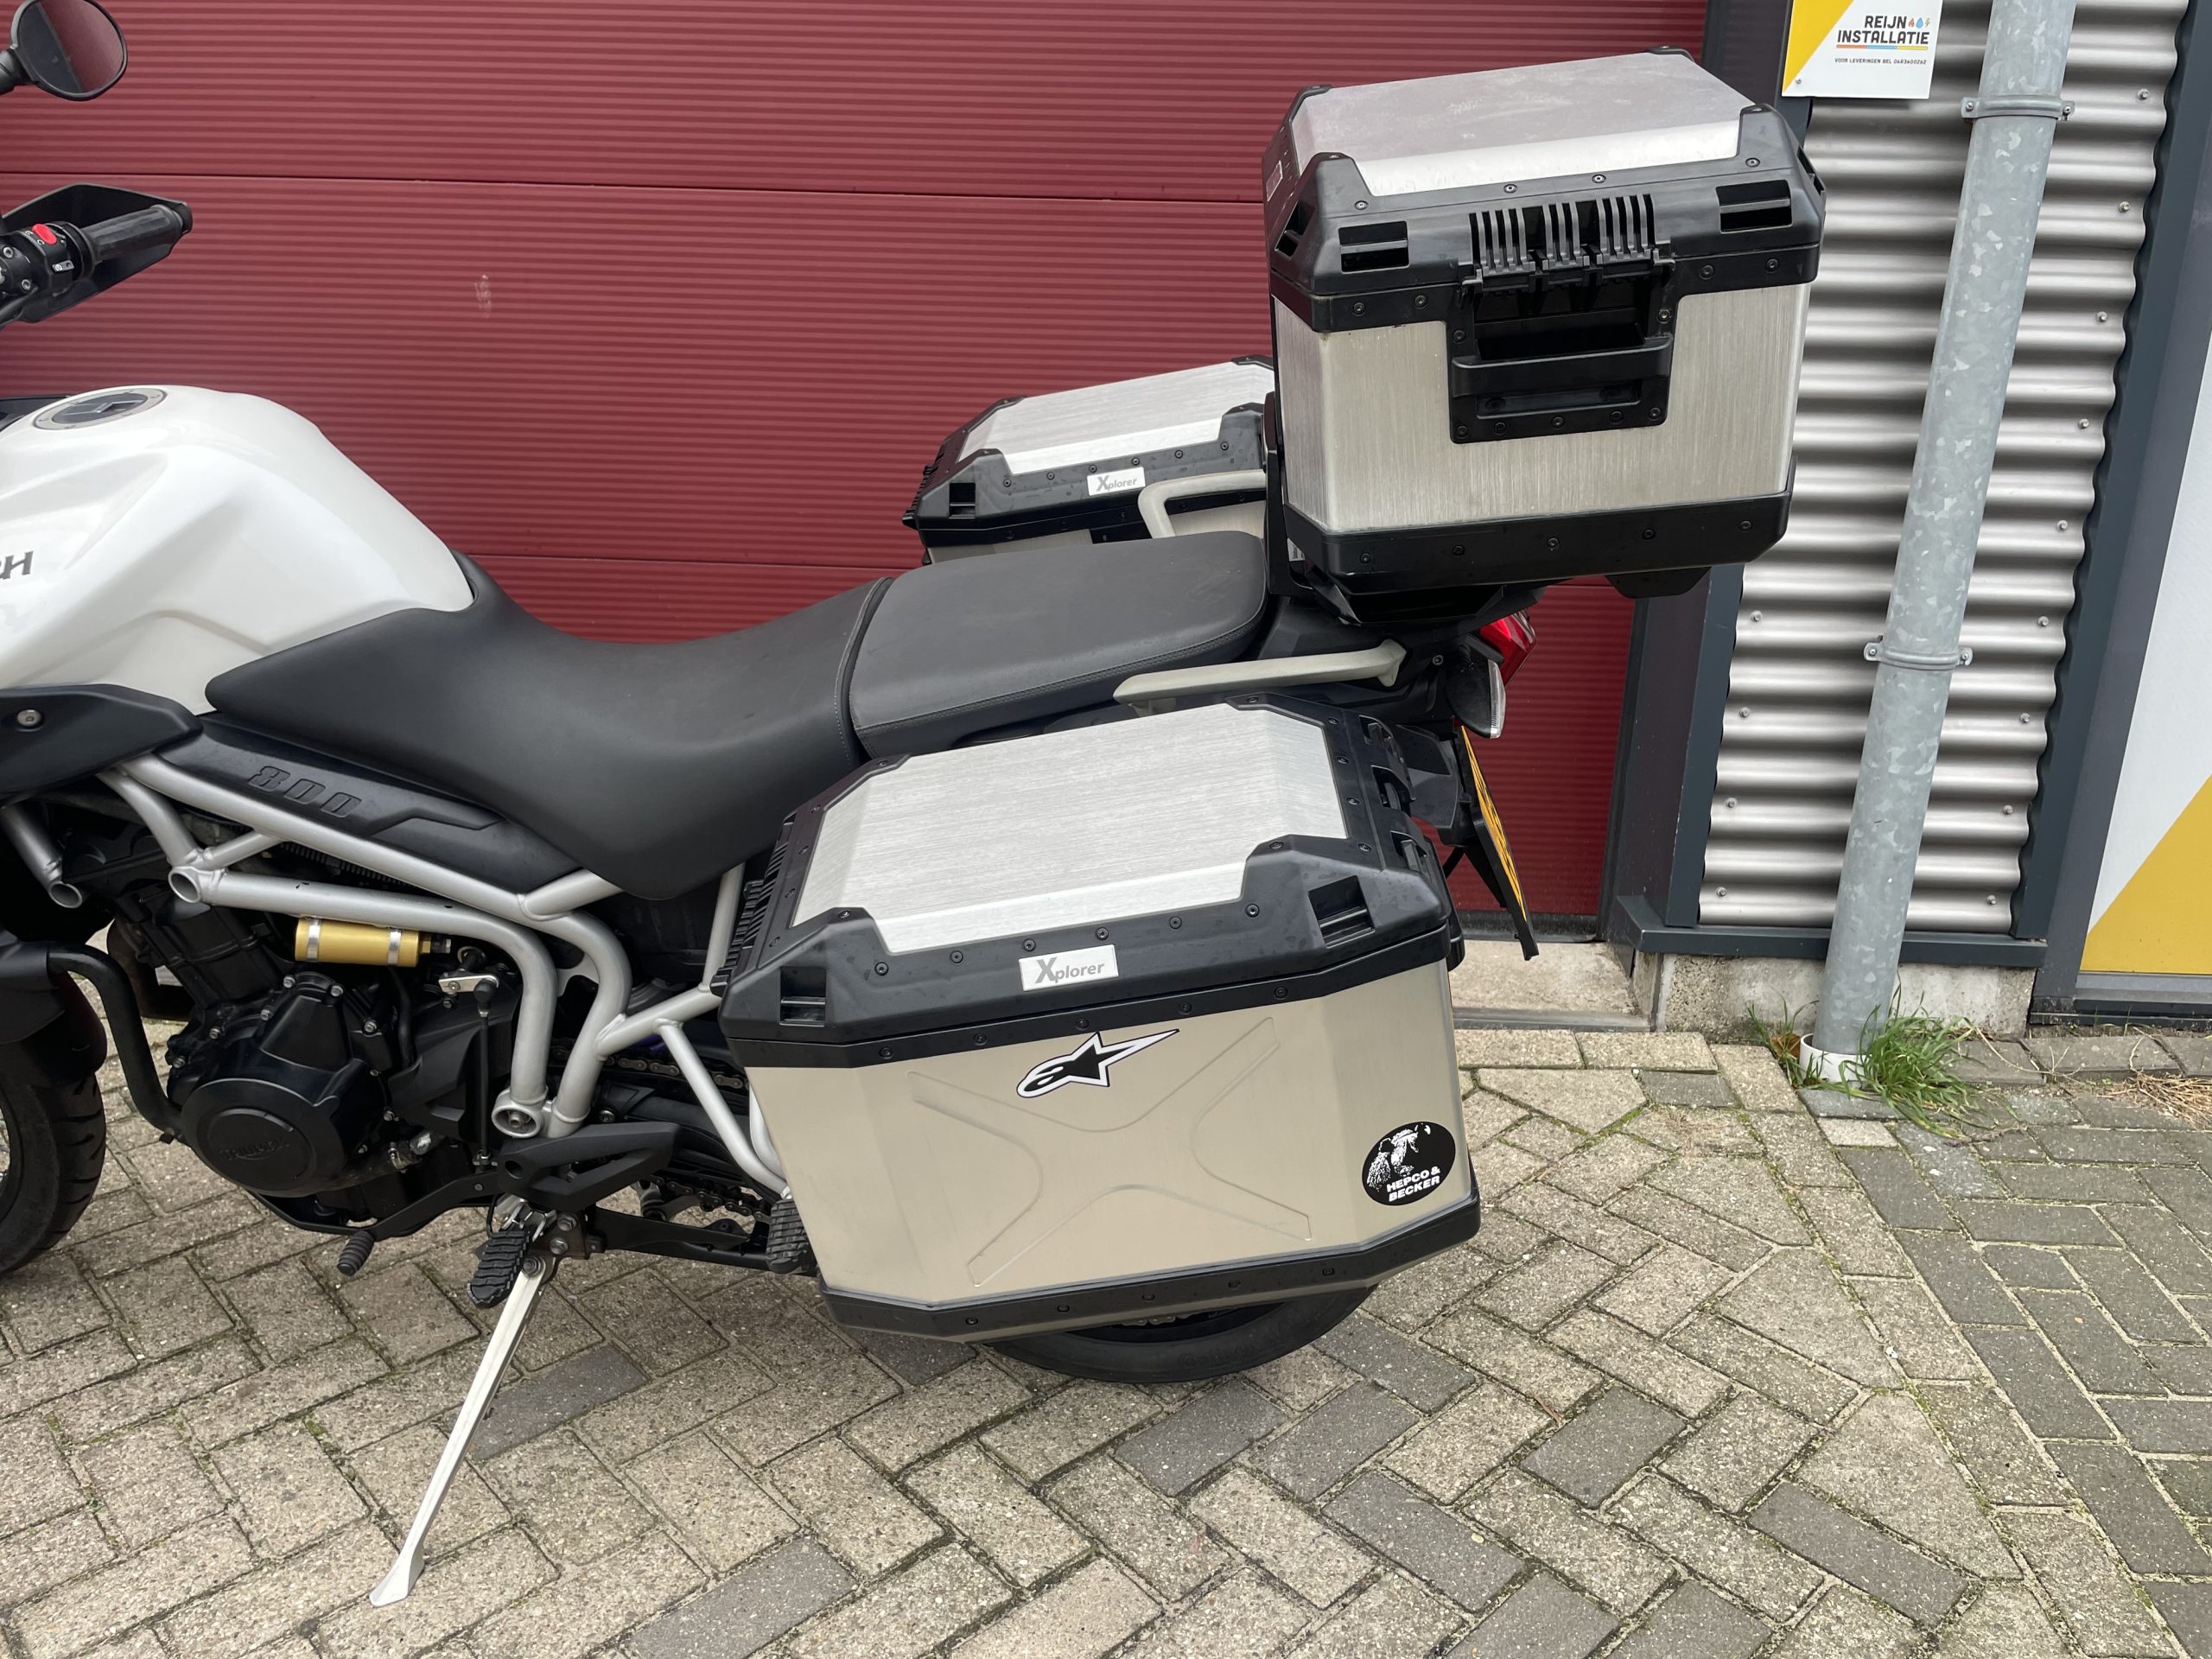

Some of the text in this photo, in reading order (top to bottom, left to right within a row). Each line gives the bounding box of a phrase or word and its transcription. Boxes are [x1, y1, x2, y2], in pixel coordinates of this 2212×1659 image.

[1864, 16, 1908, 29] REIJN
[1837, 29, 1930, 45] INSTALLATIE
[1096, 474, 1138, 492] Xplorer
[248, 766, 362, 818] 800
[1034, 957, 1105, 984] Xplorer
[1386, 1166, 1441, 1192] HEPCO &
[1389, 1175, 1440, 1202] BECKER
